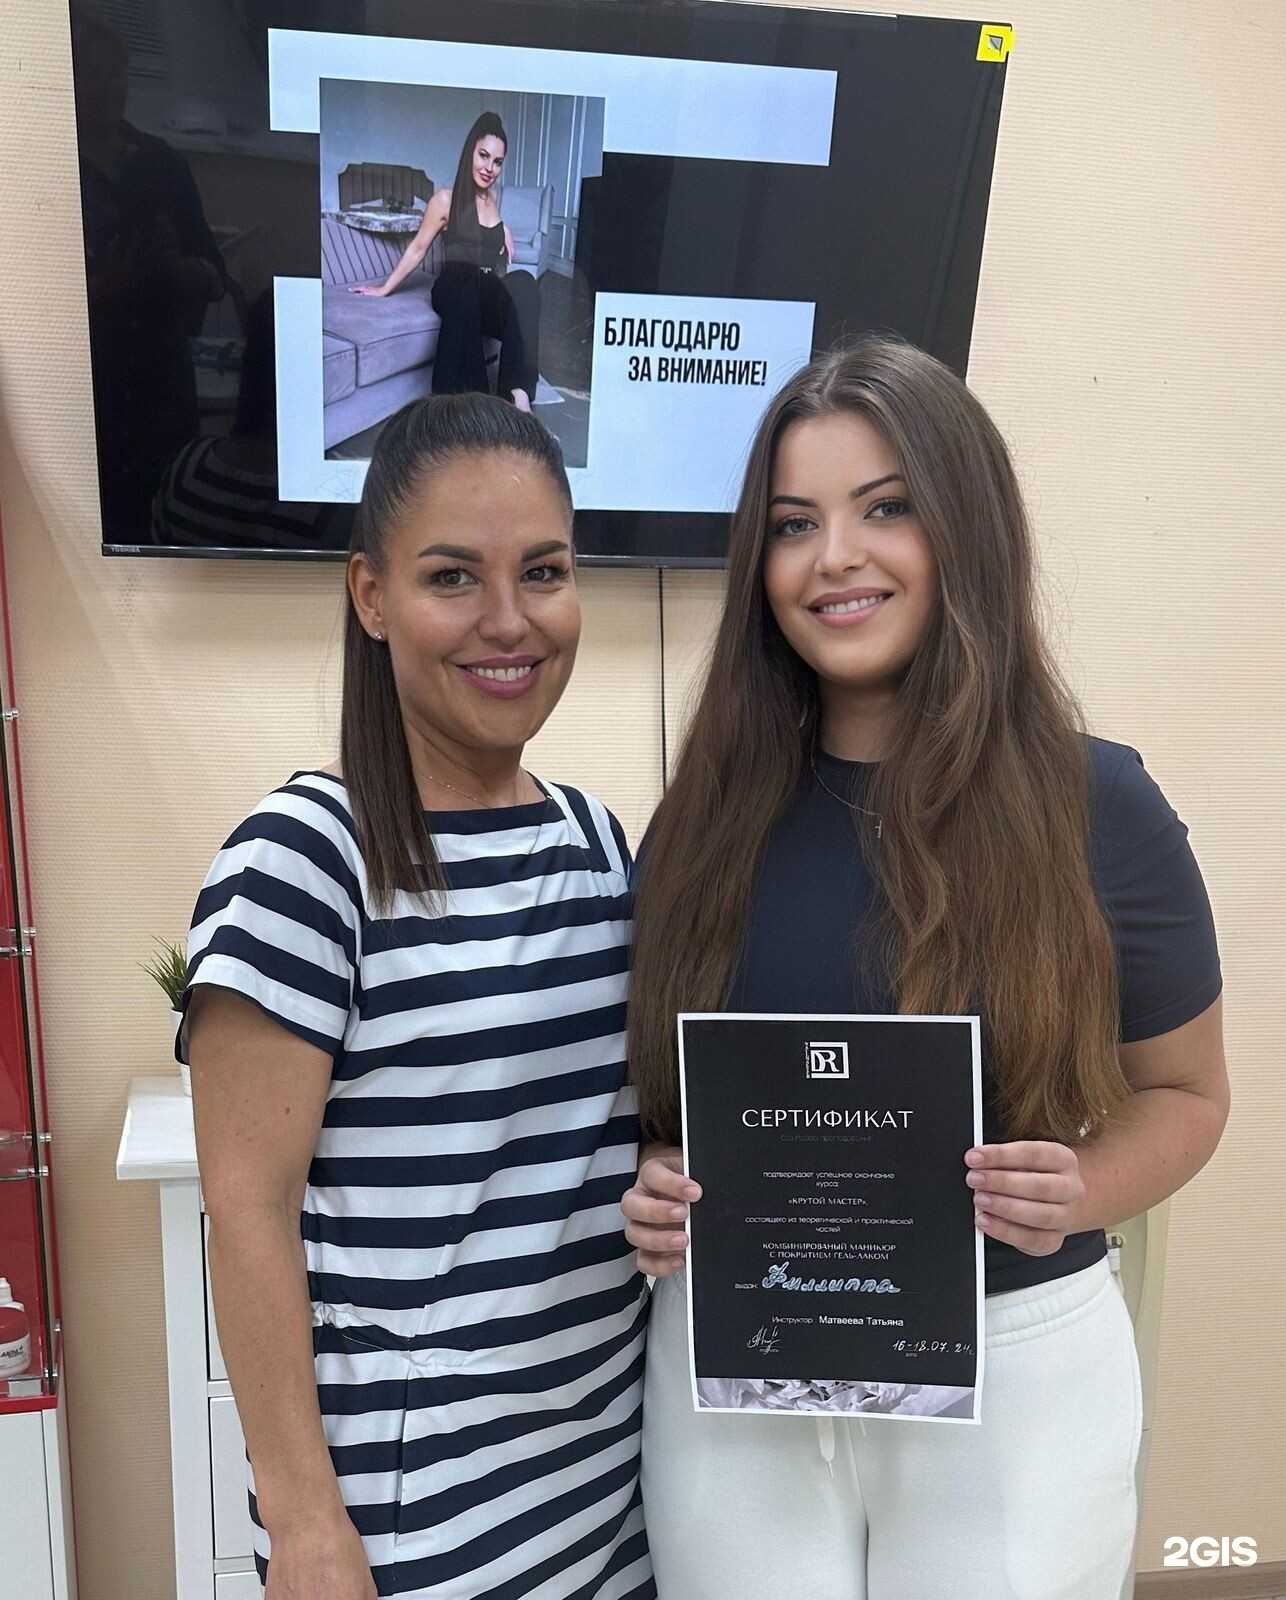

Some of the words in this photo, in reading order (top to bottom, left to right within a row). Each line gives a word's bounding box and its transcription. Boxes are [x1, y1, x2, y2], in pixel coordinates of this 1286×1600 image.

[604, 317, 741, 352] БЛАГОДАРЮ
[628, 355, 652, 382] ЗА
[657, 357, 768, 387] ВНИМАНИЕ!
[741, 1109, 914, 1129] СЕРТИФИКАТ
[816, 1171, 853, 1180] успешное
[850, 1244, 896, 1252] МАНИКЮР
[778, 1251, 831, 1260] ПОКРЫТИЕМ
[834, 1252, 889, 1261] ГЕЛЬ-ЛАКОМ
[819, 1315, 864, 1326] Матвеева
[866, 1316, 904, 1327] Татьяна
